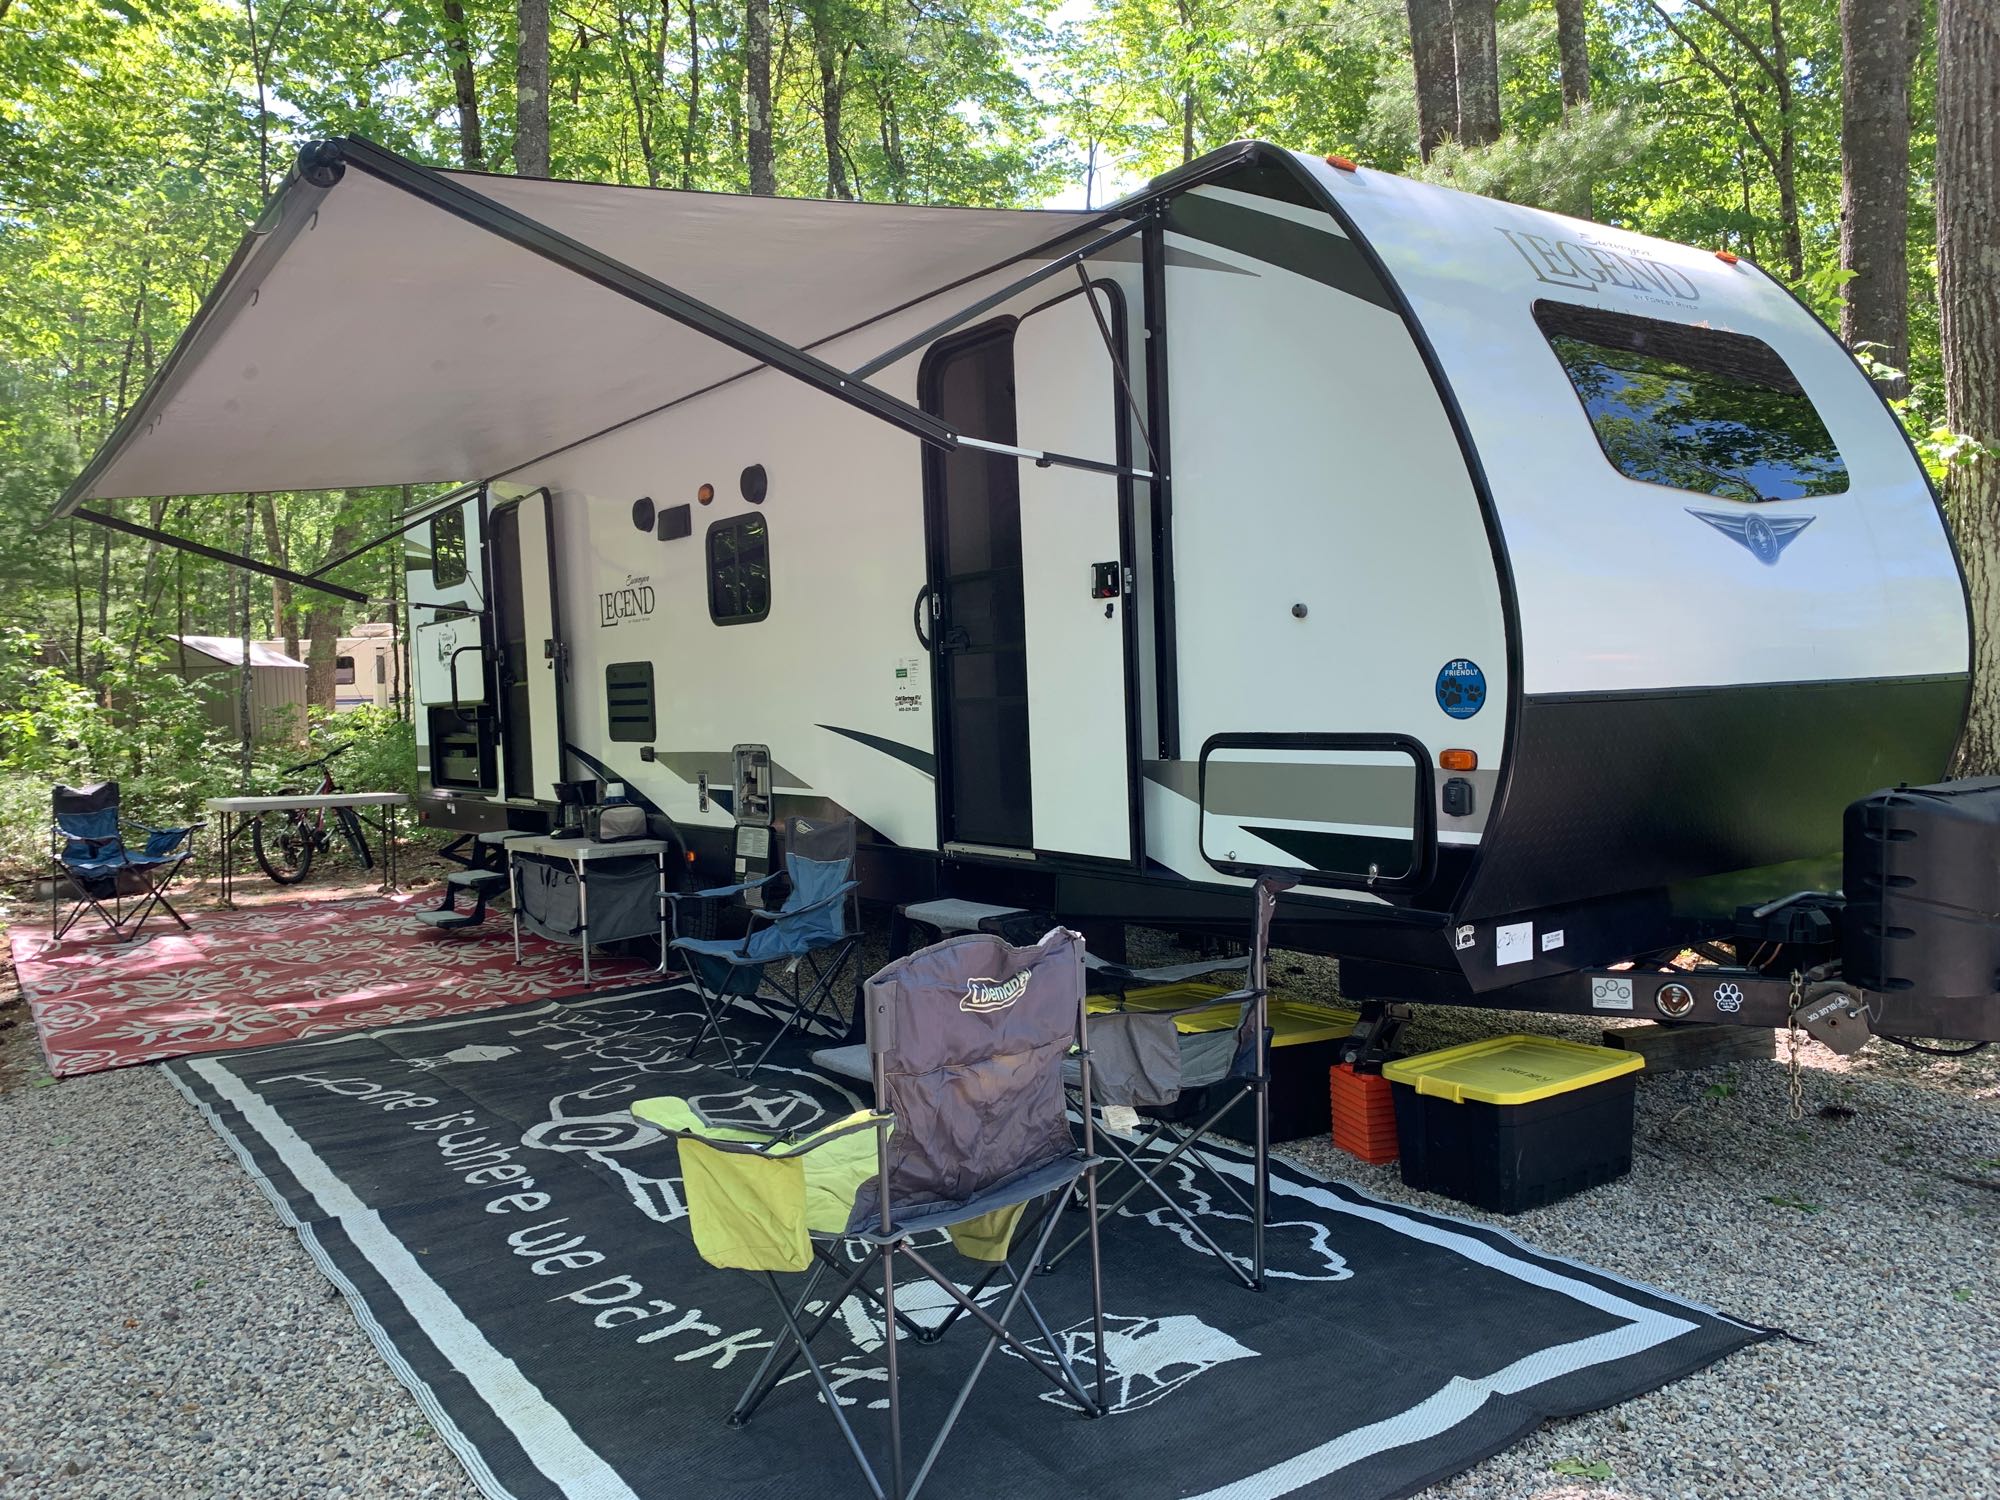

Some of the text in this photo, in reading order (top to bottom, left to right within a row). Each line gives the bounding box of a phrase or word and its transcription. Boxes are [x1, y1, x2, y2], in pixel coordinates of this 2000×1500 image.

[1494, 226, 1700, 301] LEGEND
[599, 586, 655, 628] LEGEND
[971, 968, 1031, 1004] Coleman
[1807, 1002, 1837, 1022] BLUE OX
[406, 1109, 476, 1131] is
[437, 1126, 552, 1215] where
[507, 1217, 607, 1277] we
[547, 1275, 775, 1370] park
